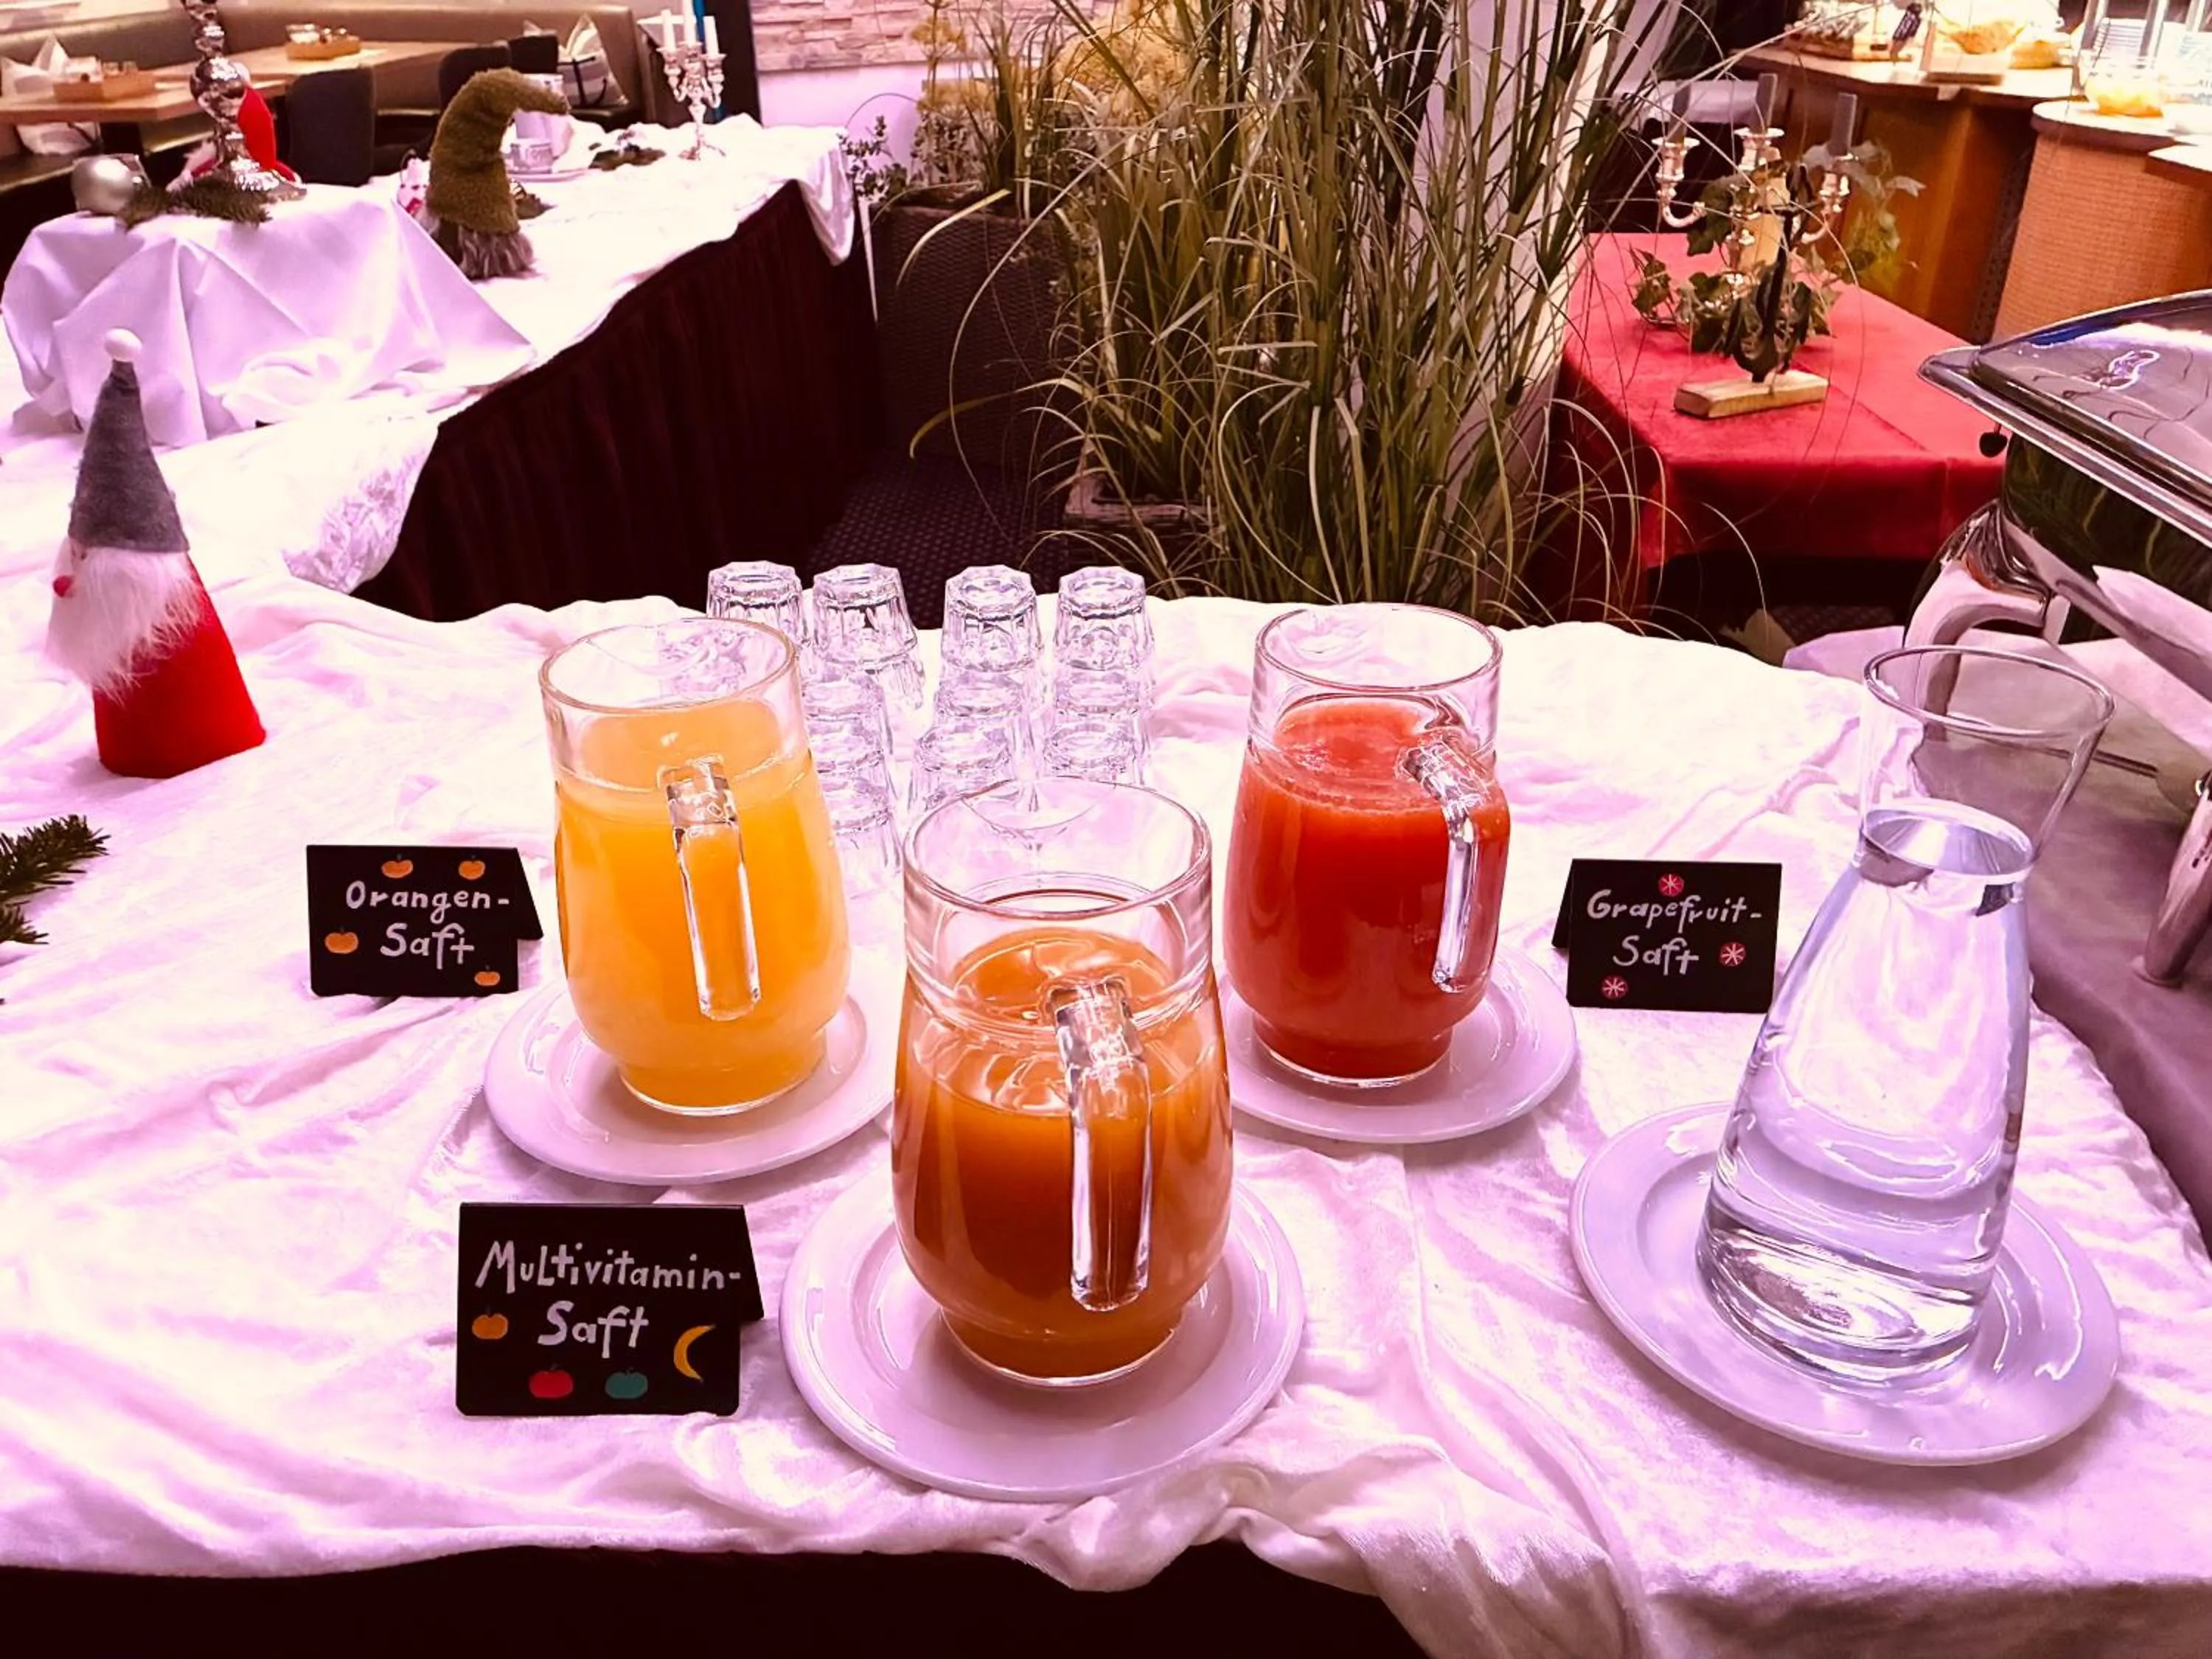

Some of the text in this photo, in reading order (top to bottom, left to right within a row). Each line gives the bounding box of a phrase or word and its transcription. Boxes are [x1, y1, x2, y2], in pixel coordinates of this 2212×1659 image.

[345, 880, 510, 924] Orangen-
[1587, 888, 1763, 933] Grapefruit-
[379, 922, 476, 970] Saft
[1612, 934, 1700, 976] Saft
[536, 1300, 650, 1360] Saft
